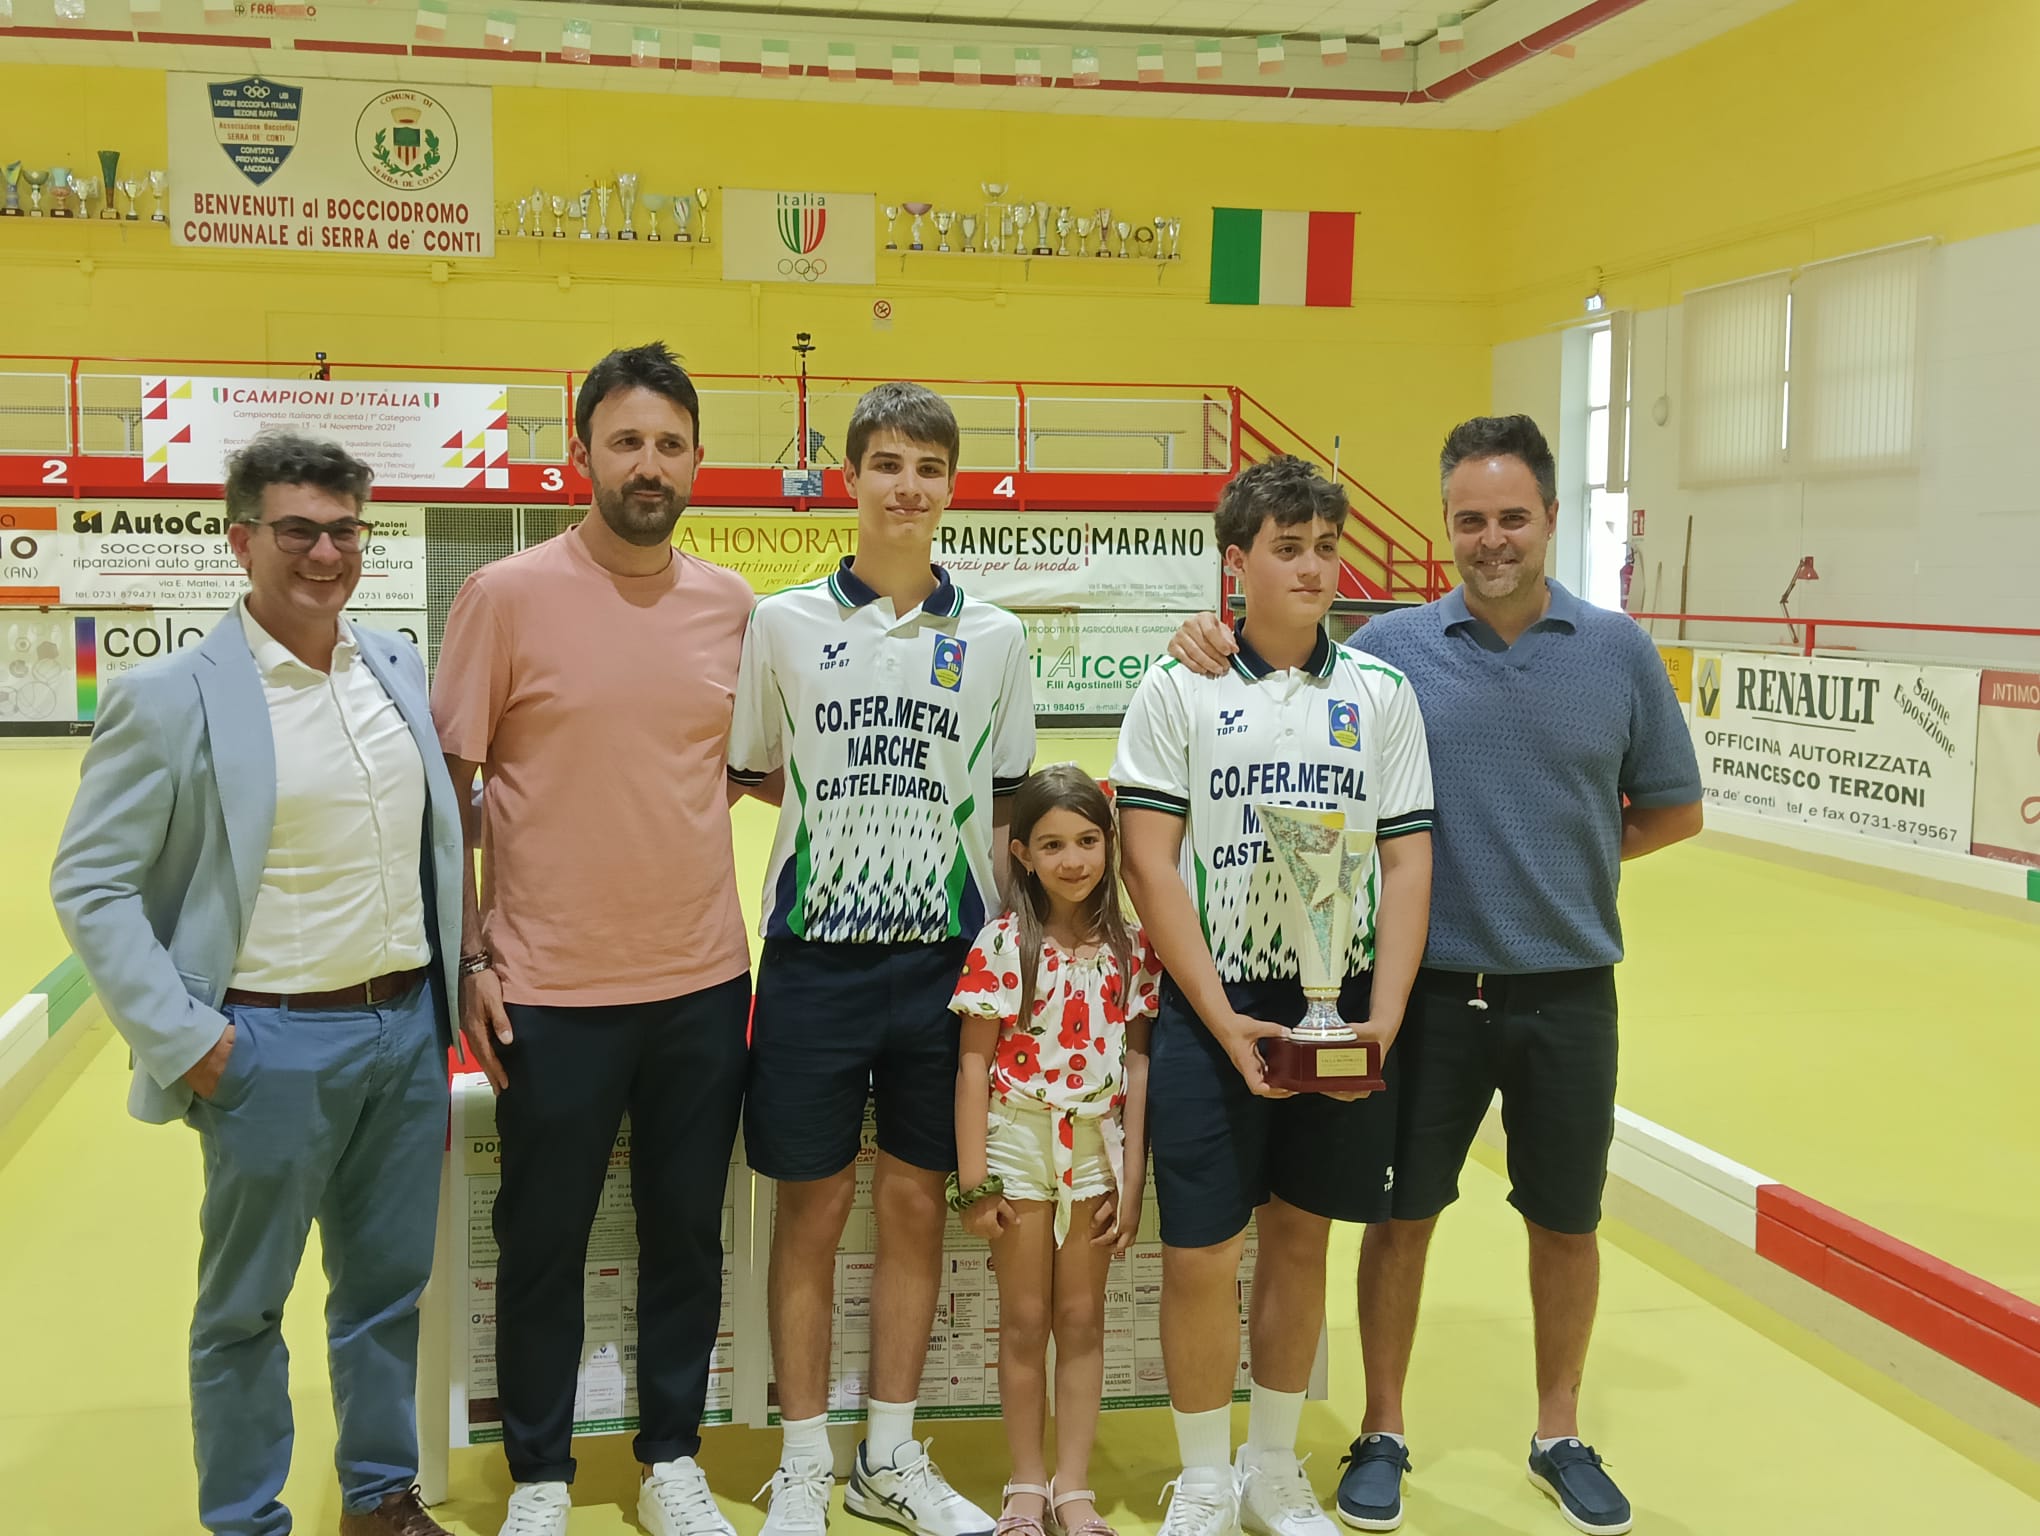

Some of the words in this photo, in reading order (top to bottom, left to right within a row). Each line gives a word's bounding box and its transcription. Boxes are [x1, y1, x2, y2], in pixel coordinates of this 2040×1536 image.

[237, 100, 270, 108] BOCCIOFILA
[380, 93, 416, 104] COMUNE
[423, 98, 433, 108] DI
[233, 109, 257, 117] SEZIONE
[219, 122, 260, 130] Associazione
[228, 133, 249, 141] SERRA
[266, 134, 285, 142] CONTI
[235, 156, 280, 164] PROVINCIALE
[243, 165, 273, 173] ANCONA
[373, 166, 398, 185] SERRA
[417, 168, 443, 186] CONTI
[777, 192, 826, 206] Italia
[194, 193, 294, 218] BENVENUTI
[303, 198, 318, 218] al
[327, 198, 469, 224] BOCCIODROMO
[184, 220, 288, 245] COMUNALE
[297, 226, 313, 247] di
[322, 226, 378, 249] SERRA
[424, 231, 480, 252] CONTI
[233, 389, 334, 405] CAMPIONI
[233, 410, 286, 419] Campionato
[324, 411, 331, 420] di
[379, 413, 421, 423] Categoria
[302, 422, 310, 430] 13
[330, 423, 373, 431] Novembre
[375, 423, 395, 431] 2021
[42, 459, 68, 484] 2
[541, 467, 564, 491] 3
[993, 475, 1016, 498] 4
[1092, 527, 1204, 556] MARANO
[100, 543, 205, 555] soccorso
[73, 556, 150, 570] riparazioni
[155, 557, 189, 569] auto
[802, 563, 809, 573] e
[982, 561, 1010, 577] per
[1014, 557, 1030, 571] la
[1034, 557, 1079, 571] moda
[4, 566, 39, 579] (AN)
[176, 580, 184, 588] E.
[765, 578, 783, 587] per
[93, 591, 116, 599] 0731
[121, 591, 156, 599] 879471
[161, 591, 176, 599] fax
[179, 591, 201, 599] 0731
[359, 592, 380, 600] 0731
[386, 592, 413, 600] 89601
[1029, 625, 1064, 634] PRODOTTI
[1067, 625, 1080, 634] PER
[1082, 625, 1133, 634] AGRICOLTURA
[107, 661, 115, 670] di
[819, 660, 837, 671] TOP
[1067, 680, 1122, 691] Agostinelli
[1736, 667, 1880, 725] RENAULT
[1913, 676, 1950, 726] Salone
[1053, 703, 1085, 711] 984015
[815, 695, 960, 742] CO.FER.METAL
[1893, 684, 1955, 758] Esposizione
[1217, 726, 1235, 736] TOP
[847, 734, 930, 770] MARCHE
[1705, 730, 1781, 756] OFFICINA
[1789, 743, 1932, 778] AUTORIZZATA
[1210, 761, 1367, 801] CO.FER.METAL
[1713, 757, 1820, 790] FRANCESCO
[1829, 775, 1925, 807] TERZONI
[1744, 793, 1776, 807] conti
[1787, 801, 1802, 814] tel
[1809, 805, 1818, 816] e
[1823, 806, 1845, 821] fax
[1850, 811, 1958, 842] 0731-879567
